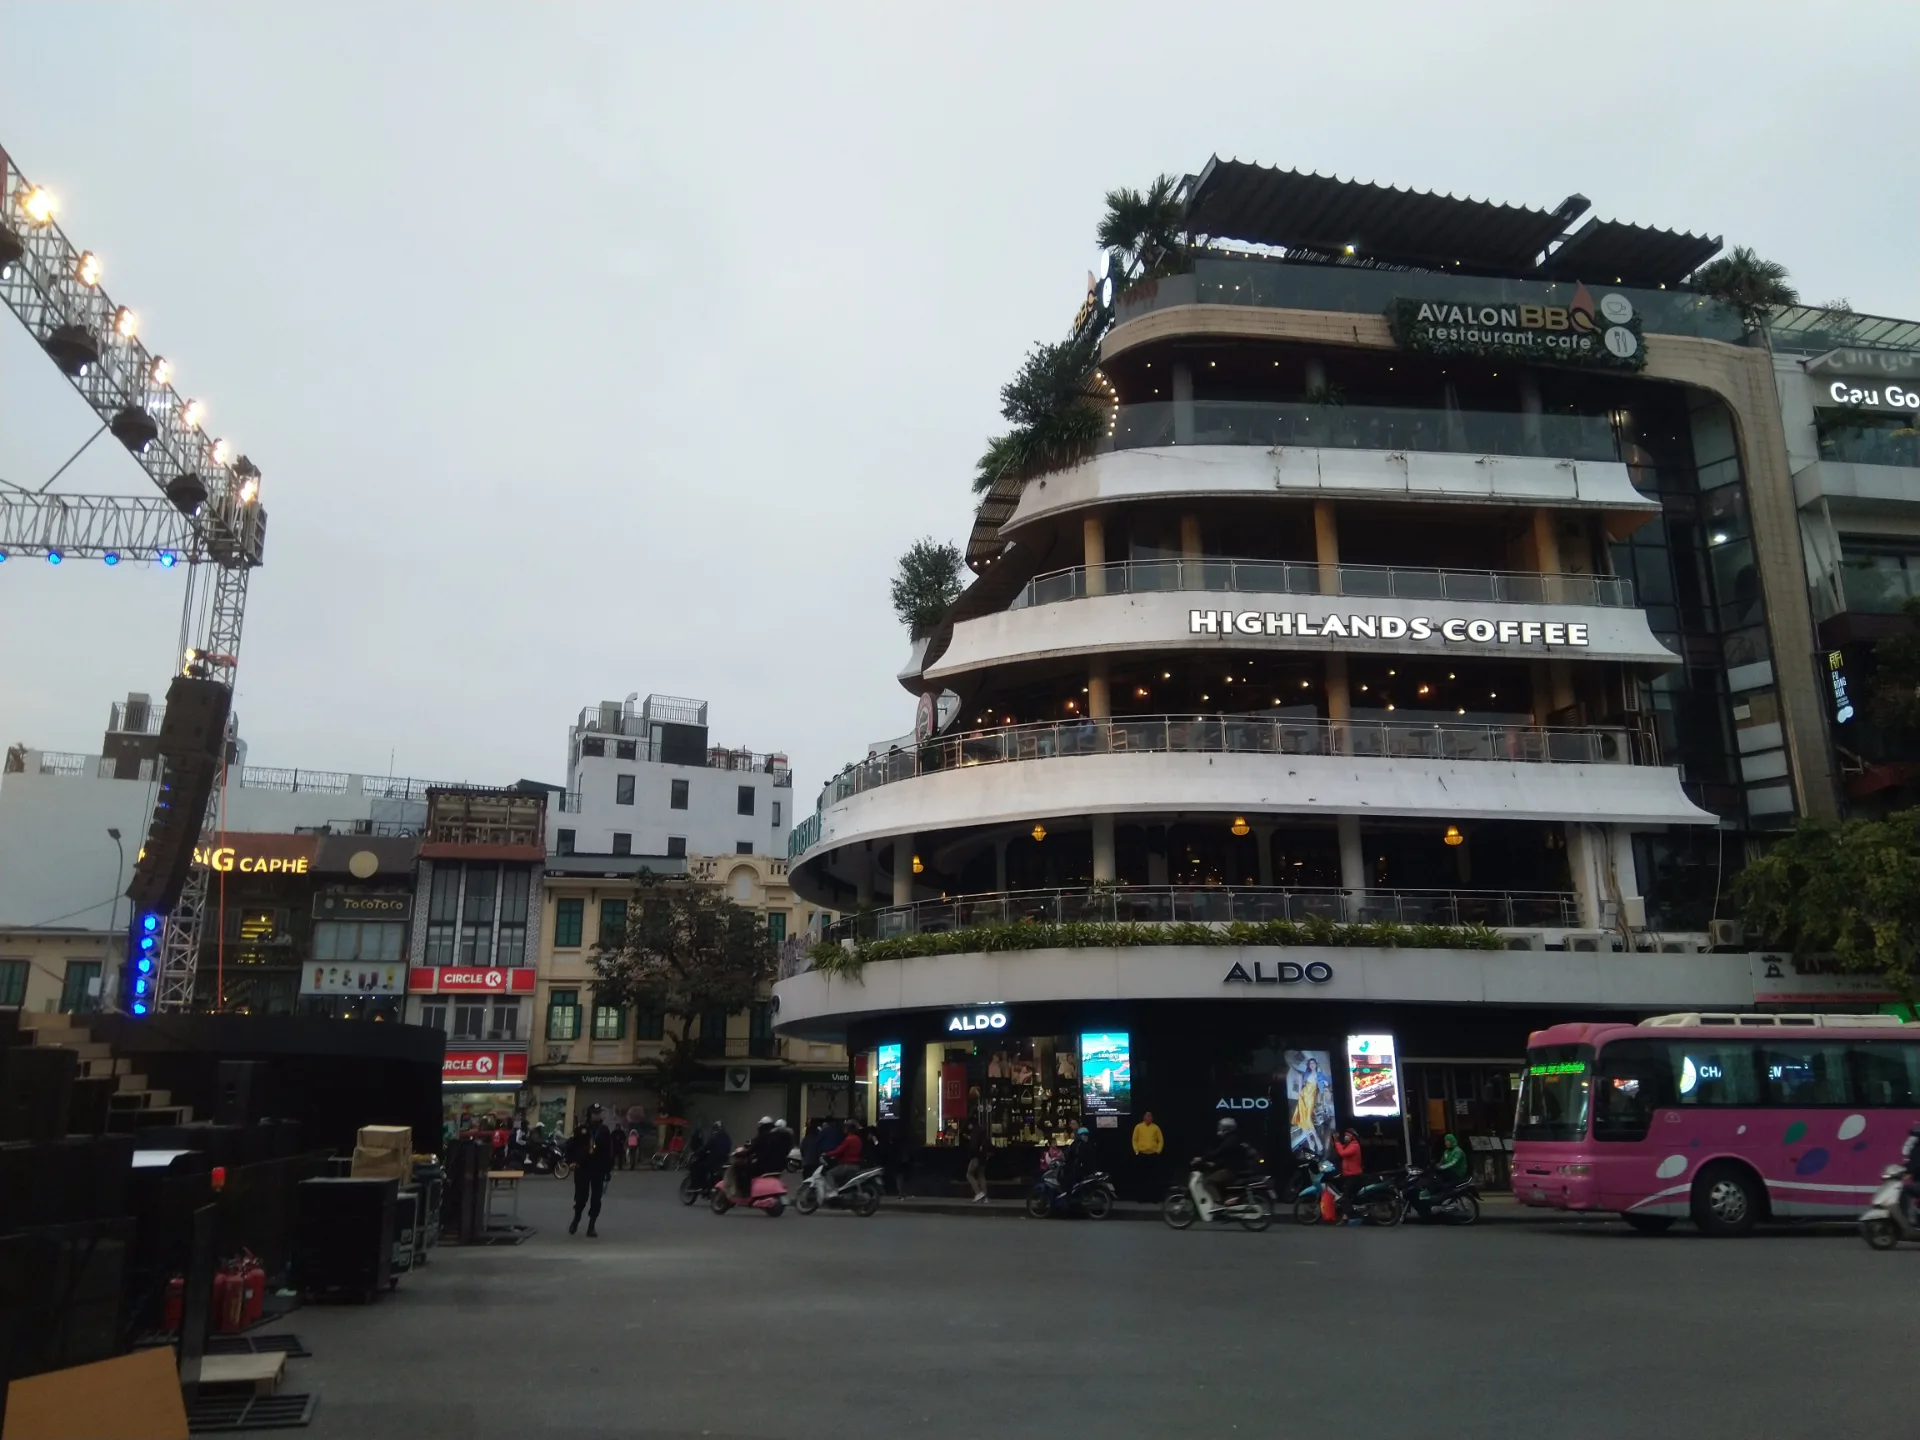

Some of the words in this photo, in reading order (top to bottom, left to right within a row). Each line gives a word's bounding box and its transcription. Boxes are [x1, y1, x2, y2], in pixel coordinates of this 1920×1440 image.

[1417, 303, 1517, 327] AVALON
[1885, 386, 1920, 408] Go
[1190, 609, 1432, 640] HIGHLANDS
[1440, 618, 1589, 647] COFFEE
[444, 973, 483, 984] CIRCLE
[1223, 961, 1333, 984] ALDO
[949, 1014, 1006, 1031] ALDO
[1215, 1098, 1269, 1109] ALDO
